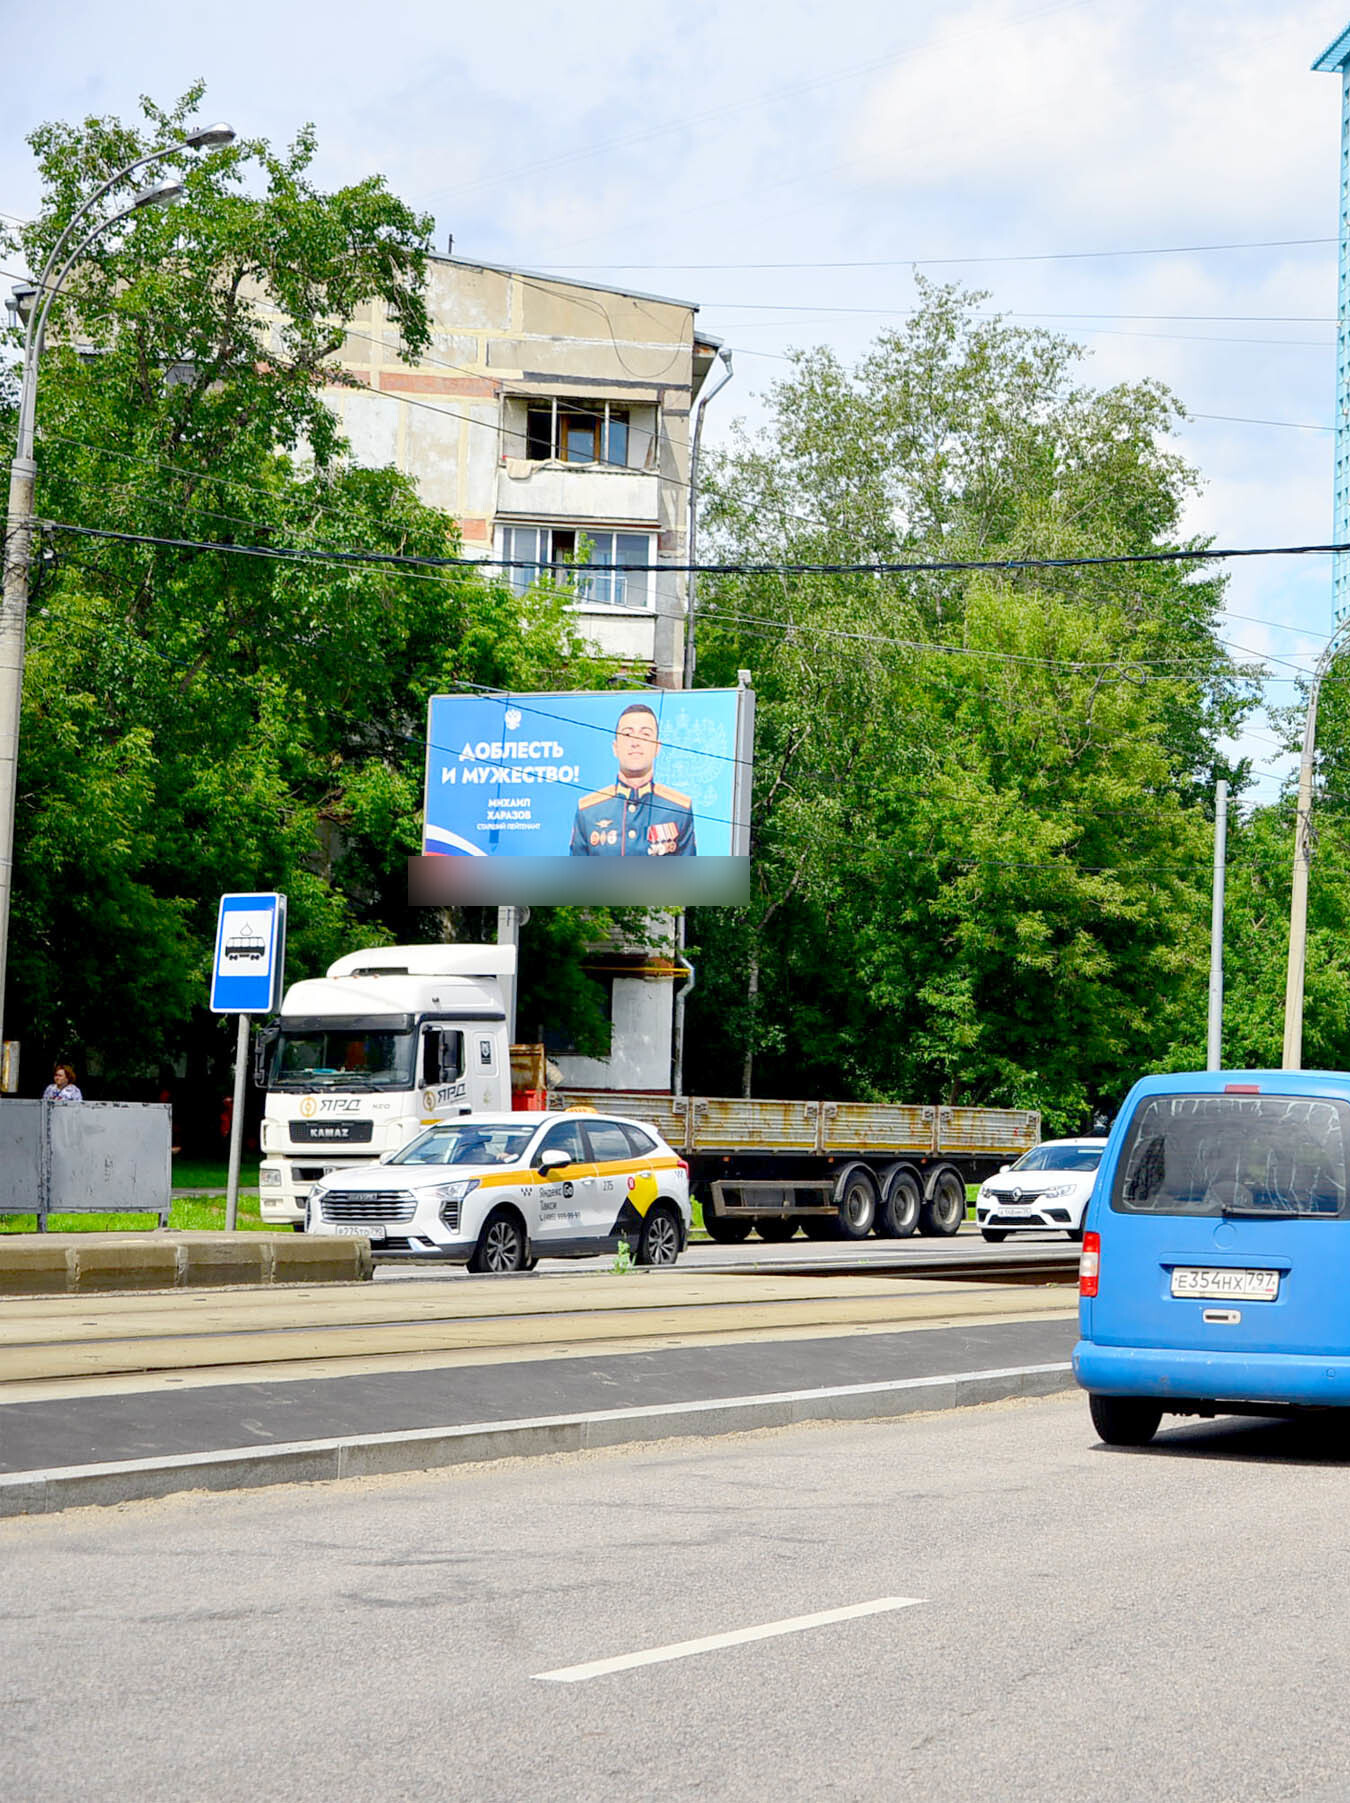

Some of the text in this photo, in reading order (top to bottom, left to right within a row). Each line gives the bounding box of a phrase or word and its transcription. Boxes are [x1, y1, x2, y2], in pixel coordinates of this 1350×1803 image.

[458, 741, 564, 762] ДОБЛЕСТЬ
[441, 765, 580, 784] И МУЖЕСТВО!
[488, 798, 531, 808] МИХАИЛ
[487, 811, 532, 820] ХАРАЗОВ
[437, 1083, 466, 1103] ЯРД
[319, 1099, 362, 1111] ЯРД
[310, 1128, 350, 1138] KAMAZ
[539, 1186, 562, 1198] Яндекс
[539, 1200, 558, 1211] Такси
[1247, 1272, 1274, 1288] 797
